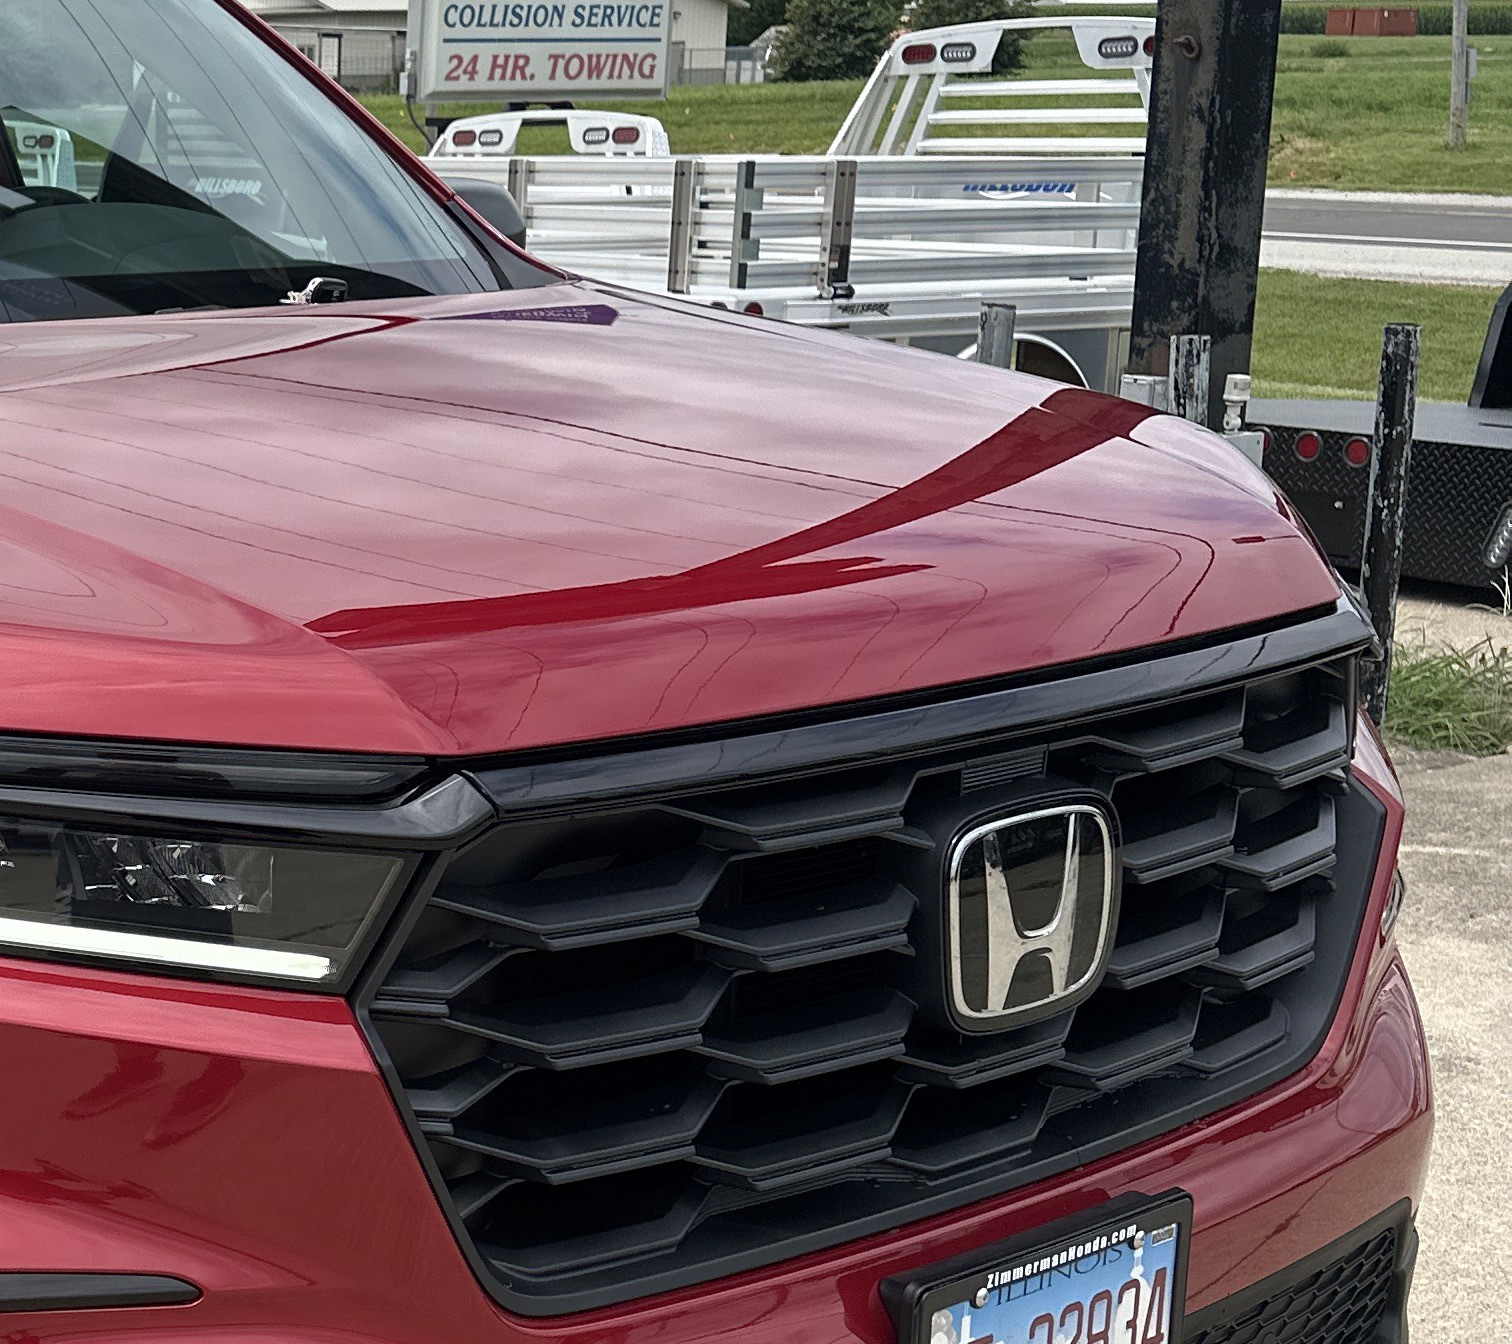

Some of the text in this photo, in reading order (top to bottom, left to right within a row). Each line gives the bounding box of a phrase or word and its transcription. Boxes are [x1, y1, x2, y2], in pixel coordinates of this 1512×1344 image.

[443, 4, 664, 28] COLLISION SERVICE
[444, 53, 658, 81] 24 HR. TOWING
[986, 1224, 1138, 1289] ZimmermanHonda.com
